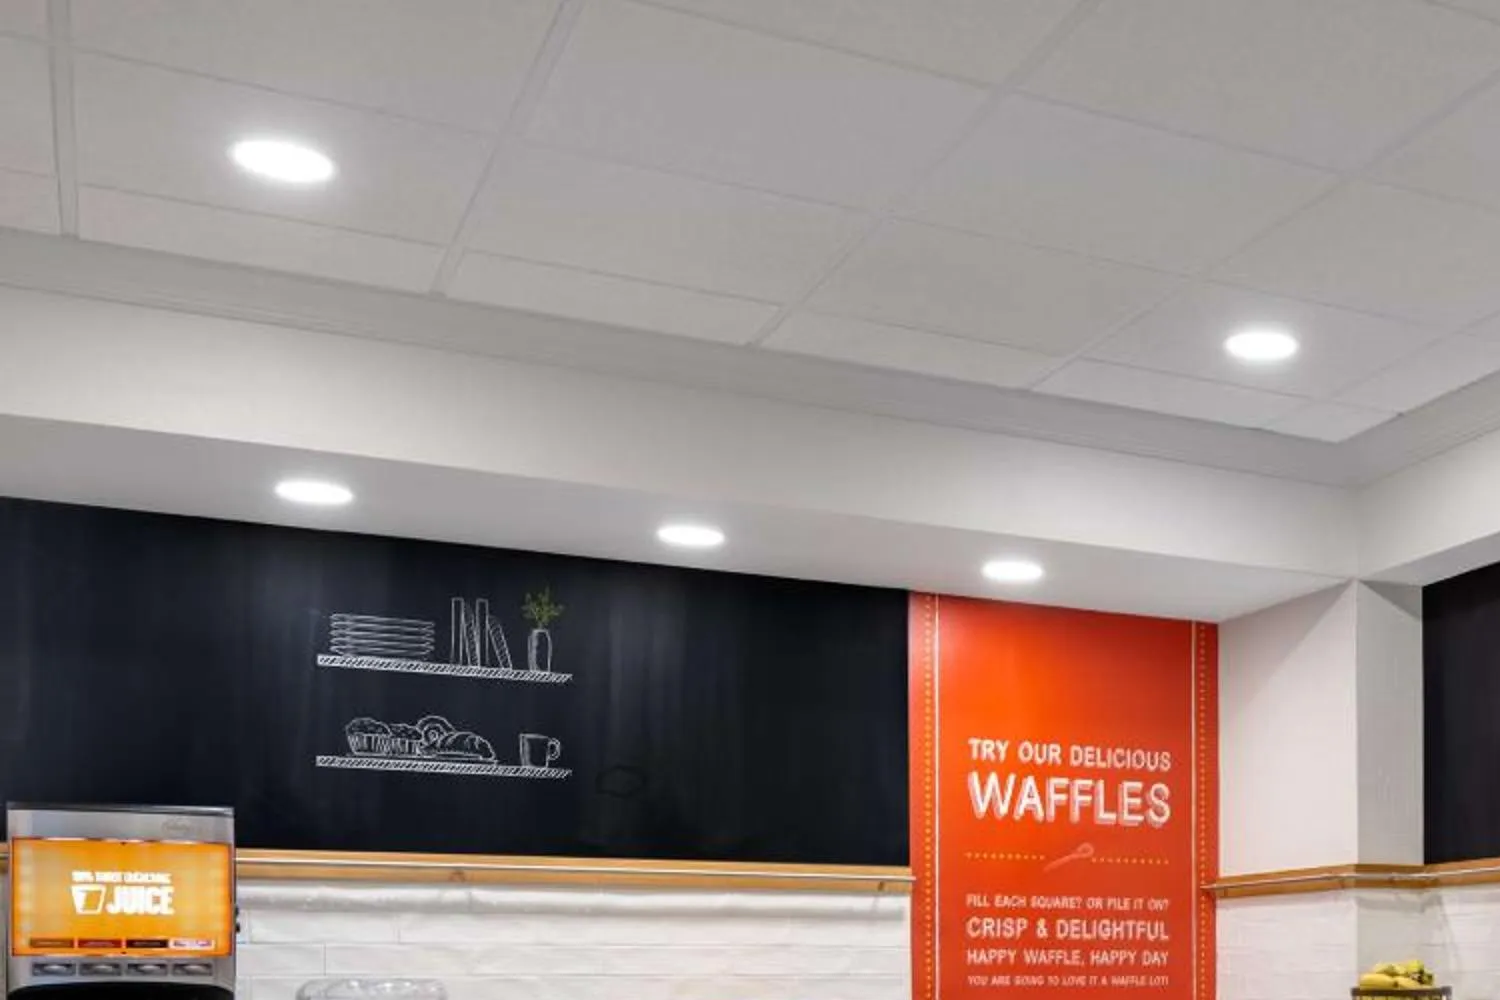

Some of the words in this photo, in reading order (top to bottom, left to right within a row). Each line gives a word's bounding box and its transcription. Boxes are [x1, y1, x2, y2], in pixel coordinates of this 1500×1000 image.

[968, 737, 1009, 762] TRY
[1018, 741, 1062, 765] OUR
[1069, 745, 1171, 772] DELICIOUS
[967, 771, 1171, 828] WAFFLES
[105, 885, 175, 915] JUICE
[966, 893, 990, 908] FILL
[994, 895, 1026, 909] EACH
[1086, 897, 1104, 910] OR
[1107, 898, 1130, 911] PILE
[1133, 898, 1143, 910] IT
[966, 916, 1028, 940] CRISP
[1036, 917, 1048, 939] &
[1056, 917, 1169, 941] DELIGHTFUL
[967, 947, 1017, 965] HAPPY
[1090, 950, 1136, 966] HAPPY
[1142, 951, 1169, 966] DAY
[968, 975, 988, 986] YOU
